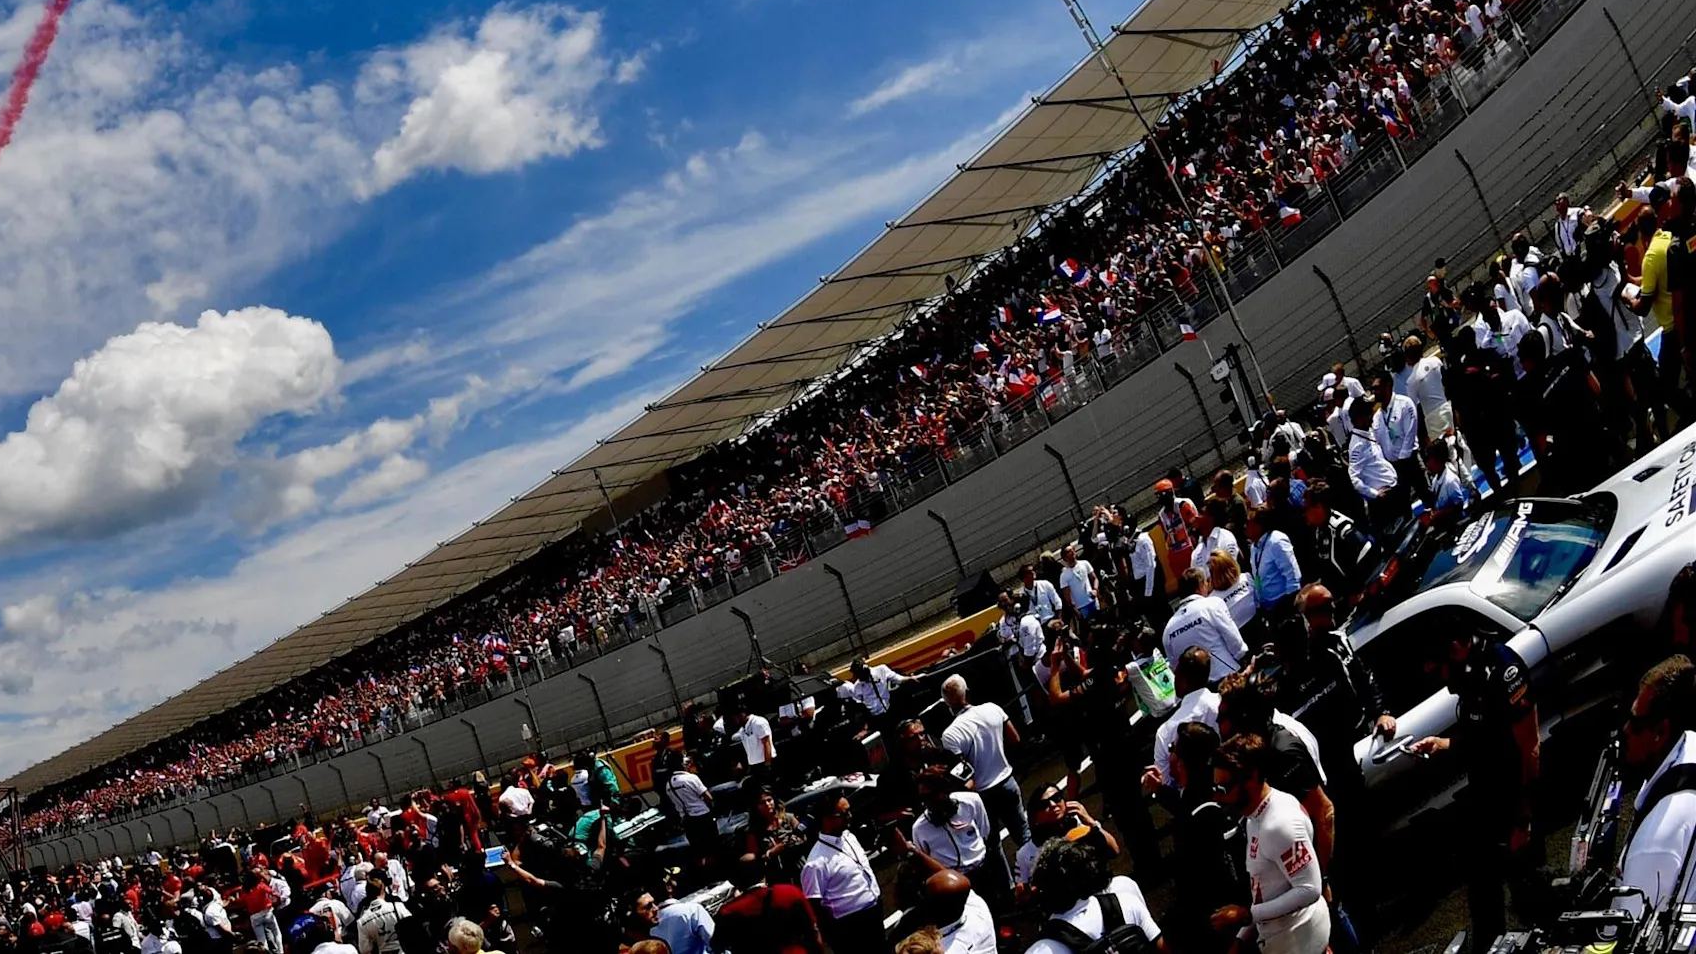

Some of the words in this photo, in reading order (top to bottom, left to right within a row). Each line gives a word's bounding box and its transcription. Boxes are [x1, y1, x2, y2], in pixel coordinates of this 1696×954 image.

[1665, 462, 1693, 528] SAFETY
[1223, 582, 1250, 604] ETRONAS
[1169, 617, 1203, 641] PETRONAS
